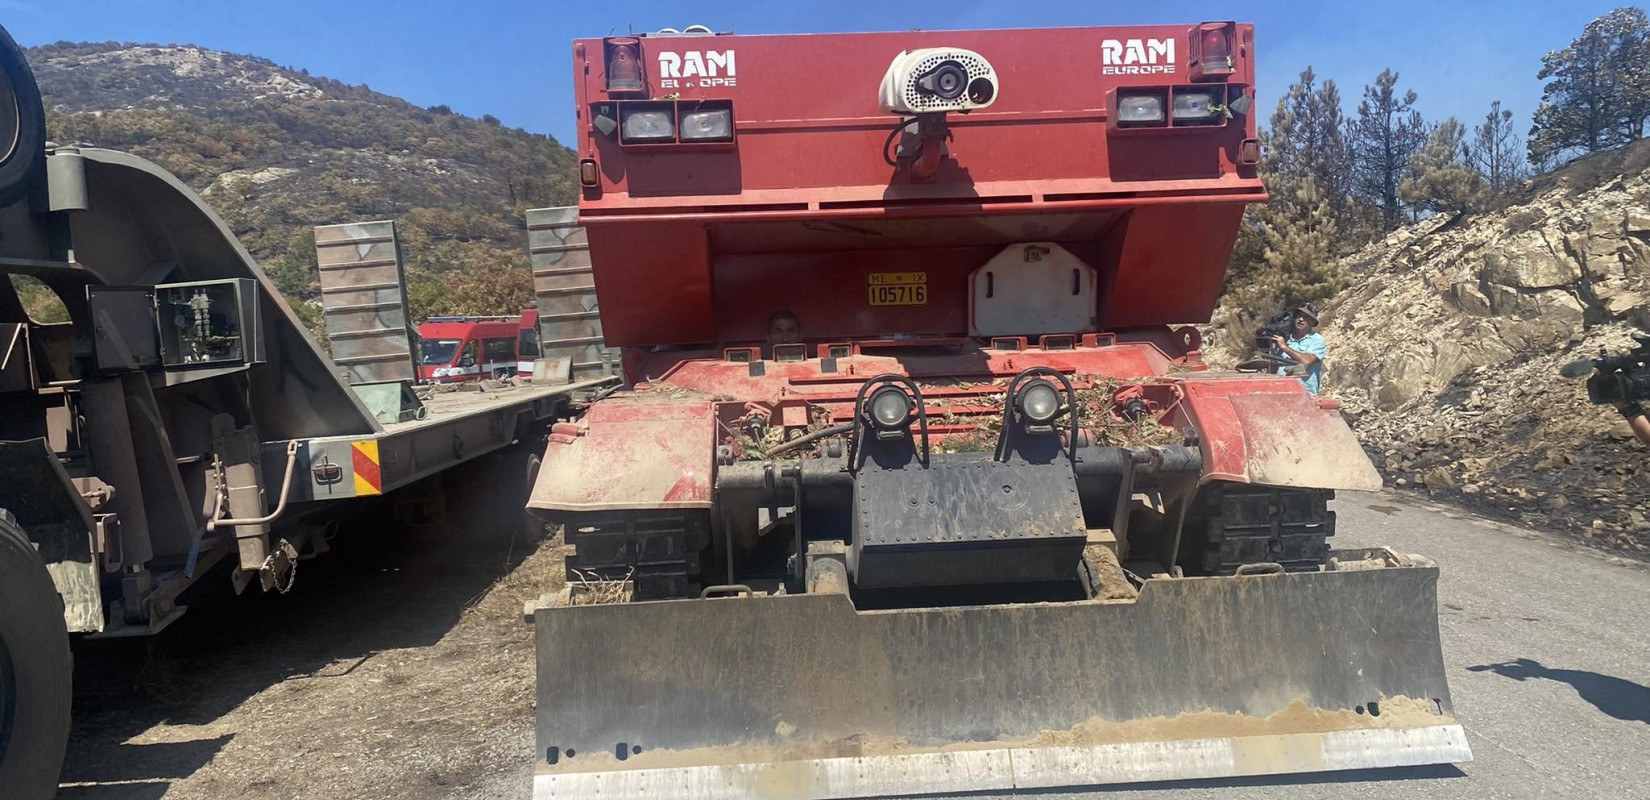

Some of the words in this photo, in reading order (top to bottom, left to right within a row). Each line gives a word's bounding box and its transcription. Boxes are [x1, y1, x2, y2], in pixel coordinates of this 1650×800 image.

[1100, 38, 1175, 65] RAM
[658, 50, 736, 78] RAM
[1102, 65, 1176, 75] EUROPE
[871, 286, 925, 303] 105716
